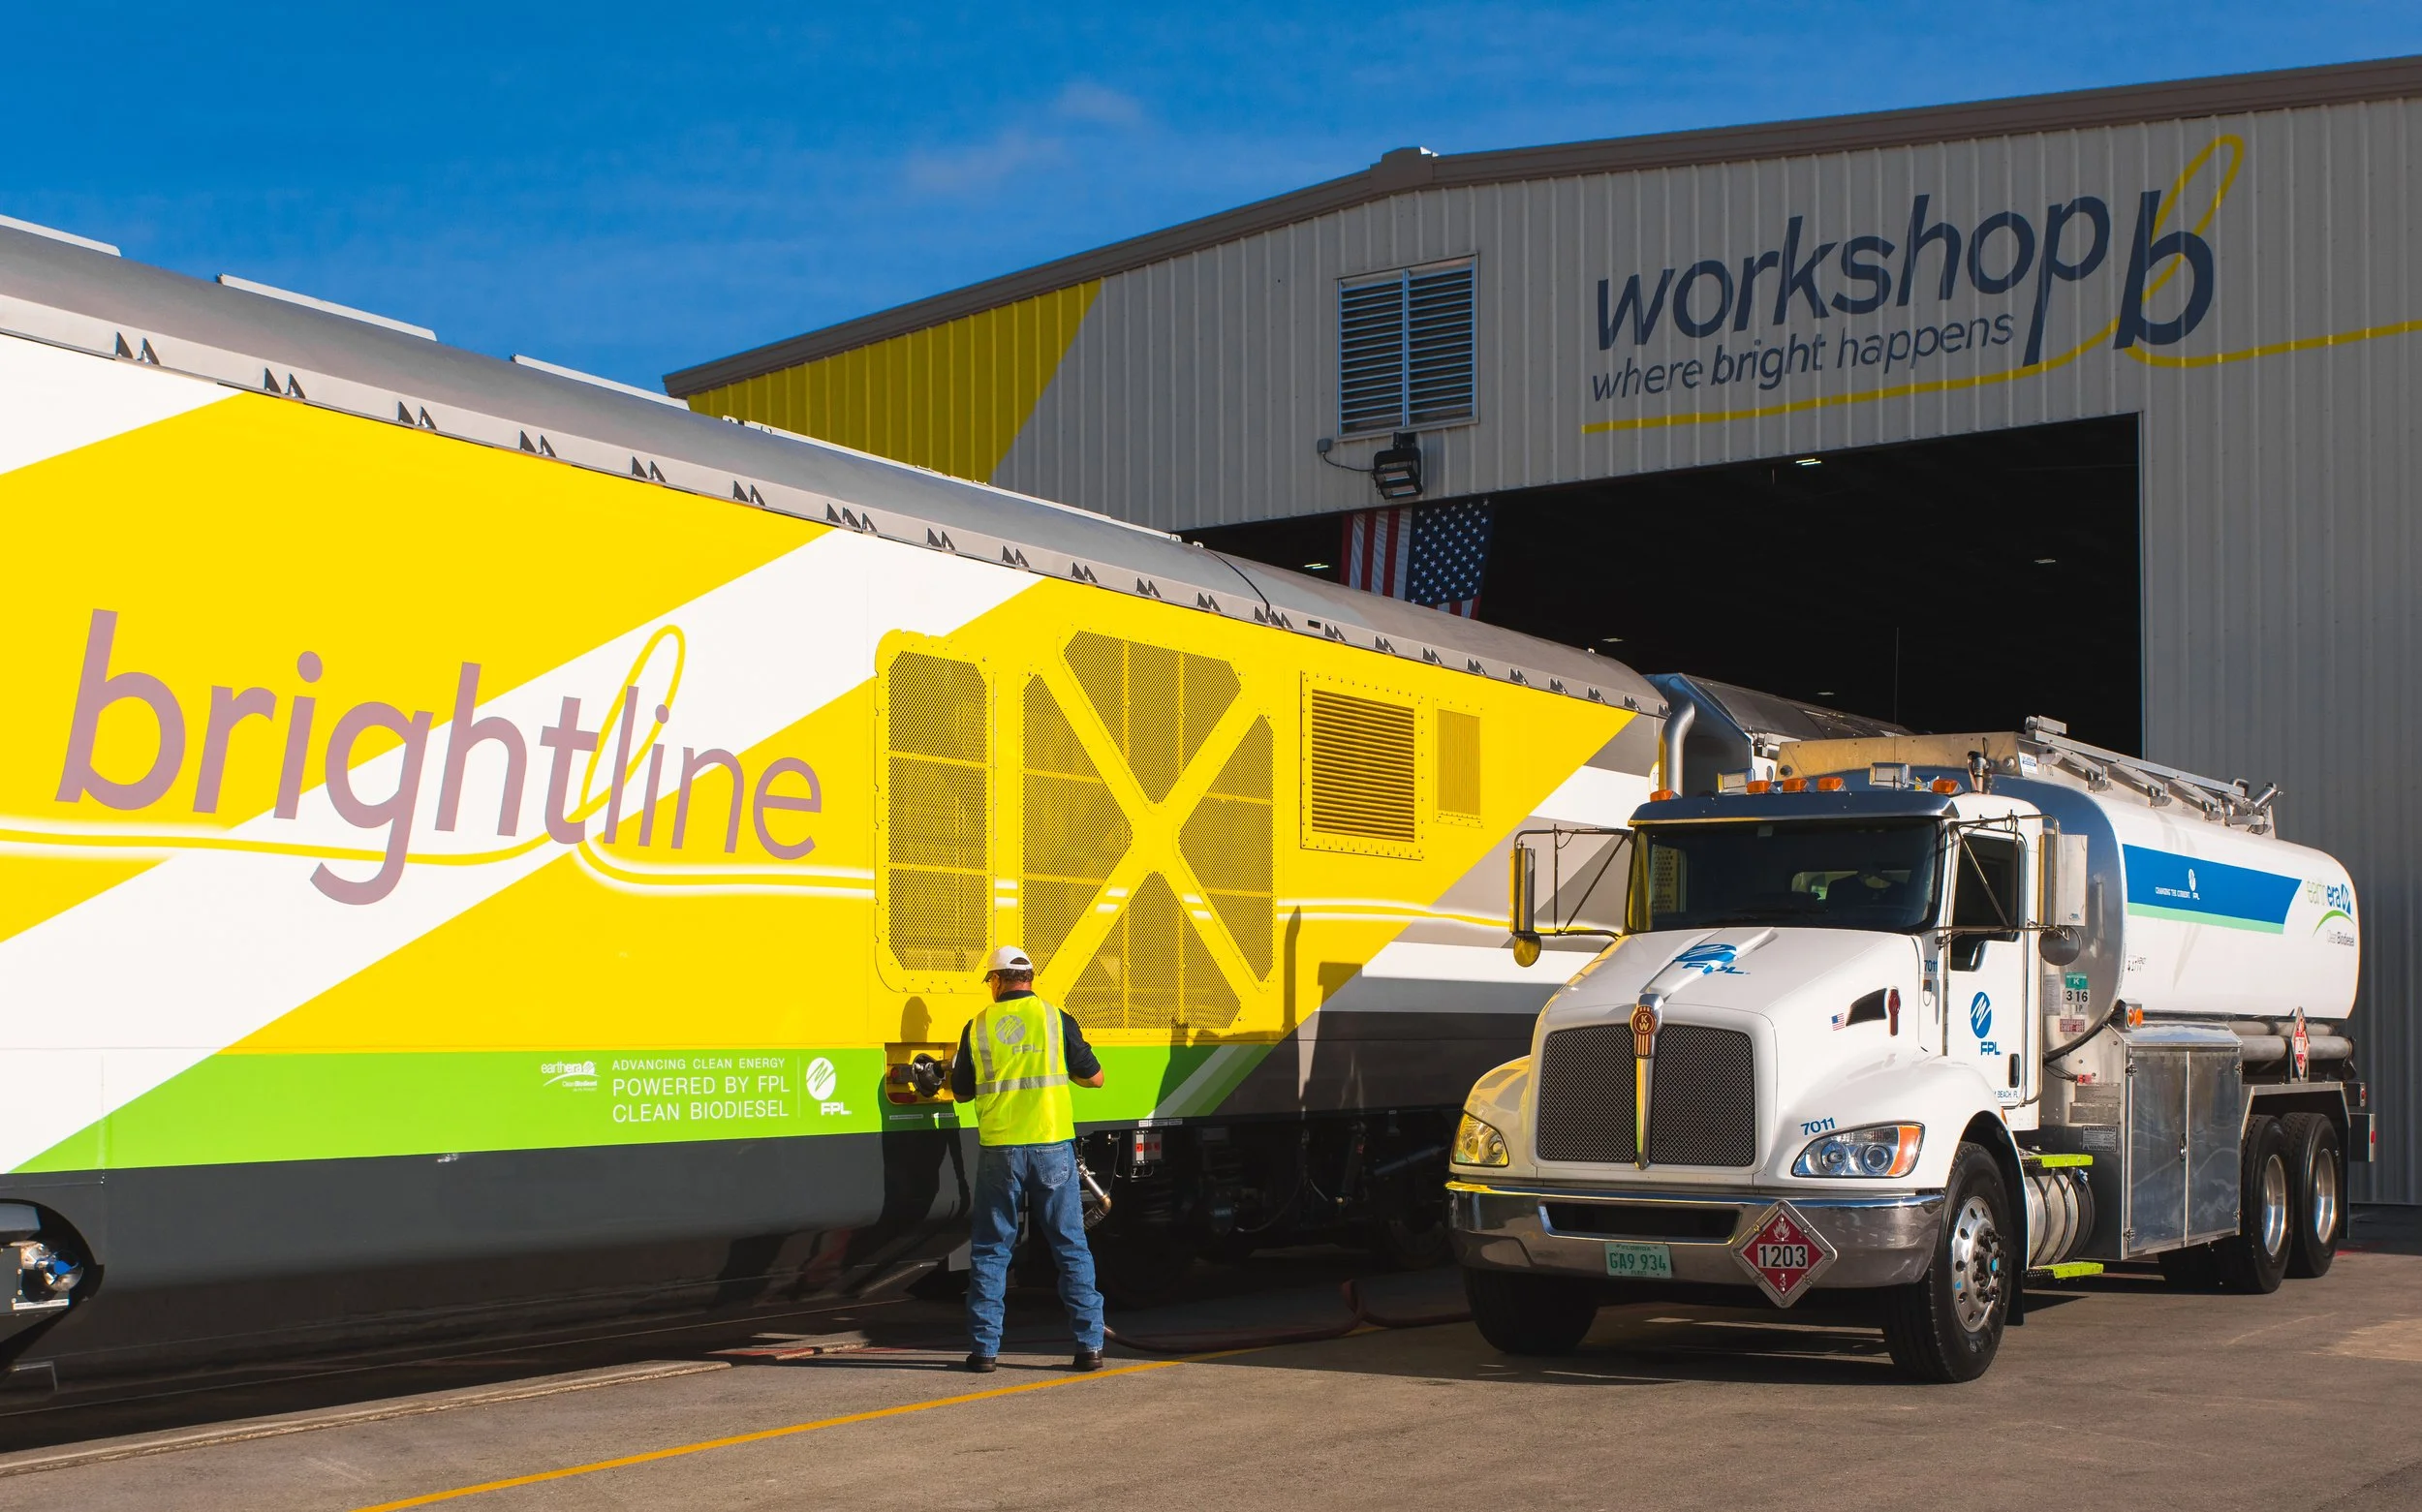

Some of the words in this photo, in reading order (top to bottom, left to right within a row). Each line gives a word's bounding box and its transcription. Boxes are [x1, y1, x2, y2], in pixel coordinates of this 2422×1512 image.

[1598, 195, 2111, 365] workshop
[2114, 190, 2215, 348] b
[1592, 357, 1703, 401] where
[1711, 333, 1827, 390] bright
[1837, 313, 2014, 374] happens
[55, 608, 822, 906] brightline
[2066, 990, 2073, 1002] 3
[2075, 991, 2089, 1003] 16
[1012, 1043, 1042, 1055] FPL
[1980, 1041, 2001, 1056] FPL
[542, 1062, 582, 1073] earthera
[612, 1059, 687, 1070] ADVANCING
[693, 1058, 732, 1069] CLEAN
[739, 1058, 786, 1068] ENERGY
[613, 1076, 716, 1096] POWERED
[726, 1076, 750, 1094] BY
[759, 1075, 790, 1093] FPL
[613, 1103, 680, 1123] CLEAN
[691, 1100, 789, 1120] BIODIESEL
[821, 1101, 851, 1116] FPL
[1800, 1117, 1836, 1135] 7011
[1609, 1252, 1635, 1270] GA9
[1640, 1253, 1667, 1271] 934
[1759, 1245, 1806, 1268] 1203
